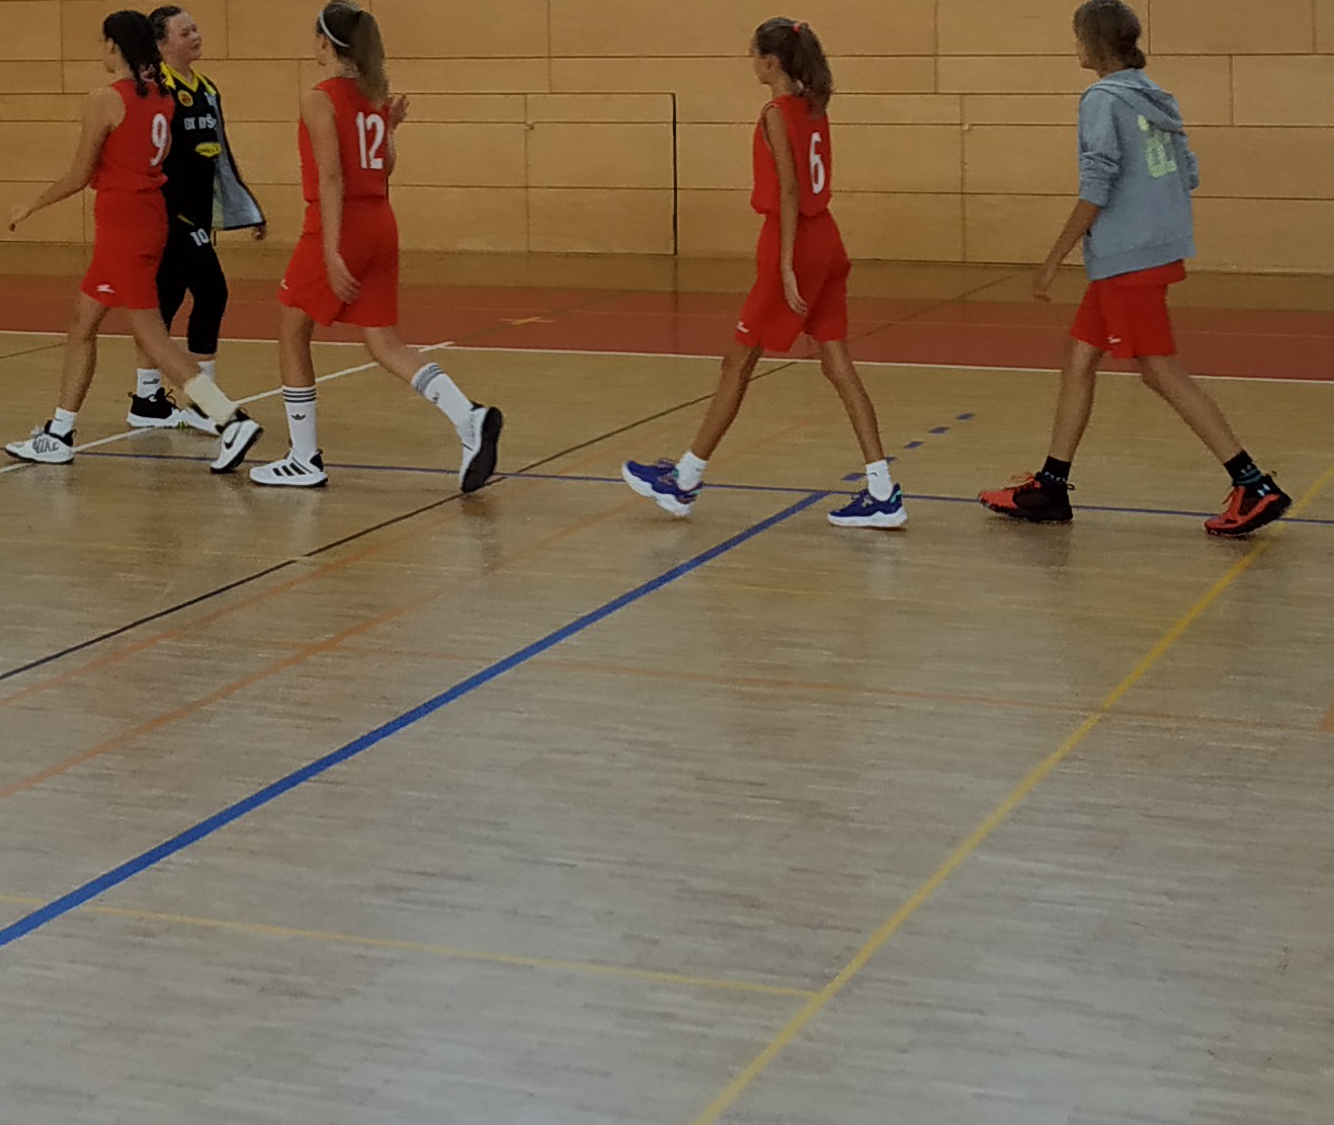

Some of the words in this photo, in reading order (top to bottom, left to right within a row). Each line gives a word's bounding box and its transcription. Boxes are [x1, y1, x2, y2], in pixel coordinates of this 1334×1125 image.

[151, 112, 168, 167] 9
[355, 111, 385, 170] 12
[808, 131, 826, 194] 6
[190, 228, 210, 247] 10
